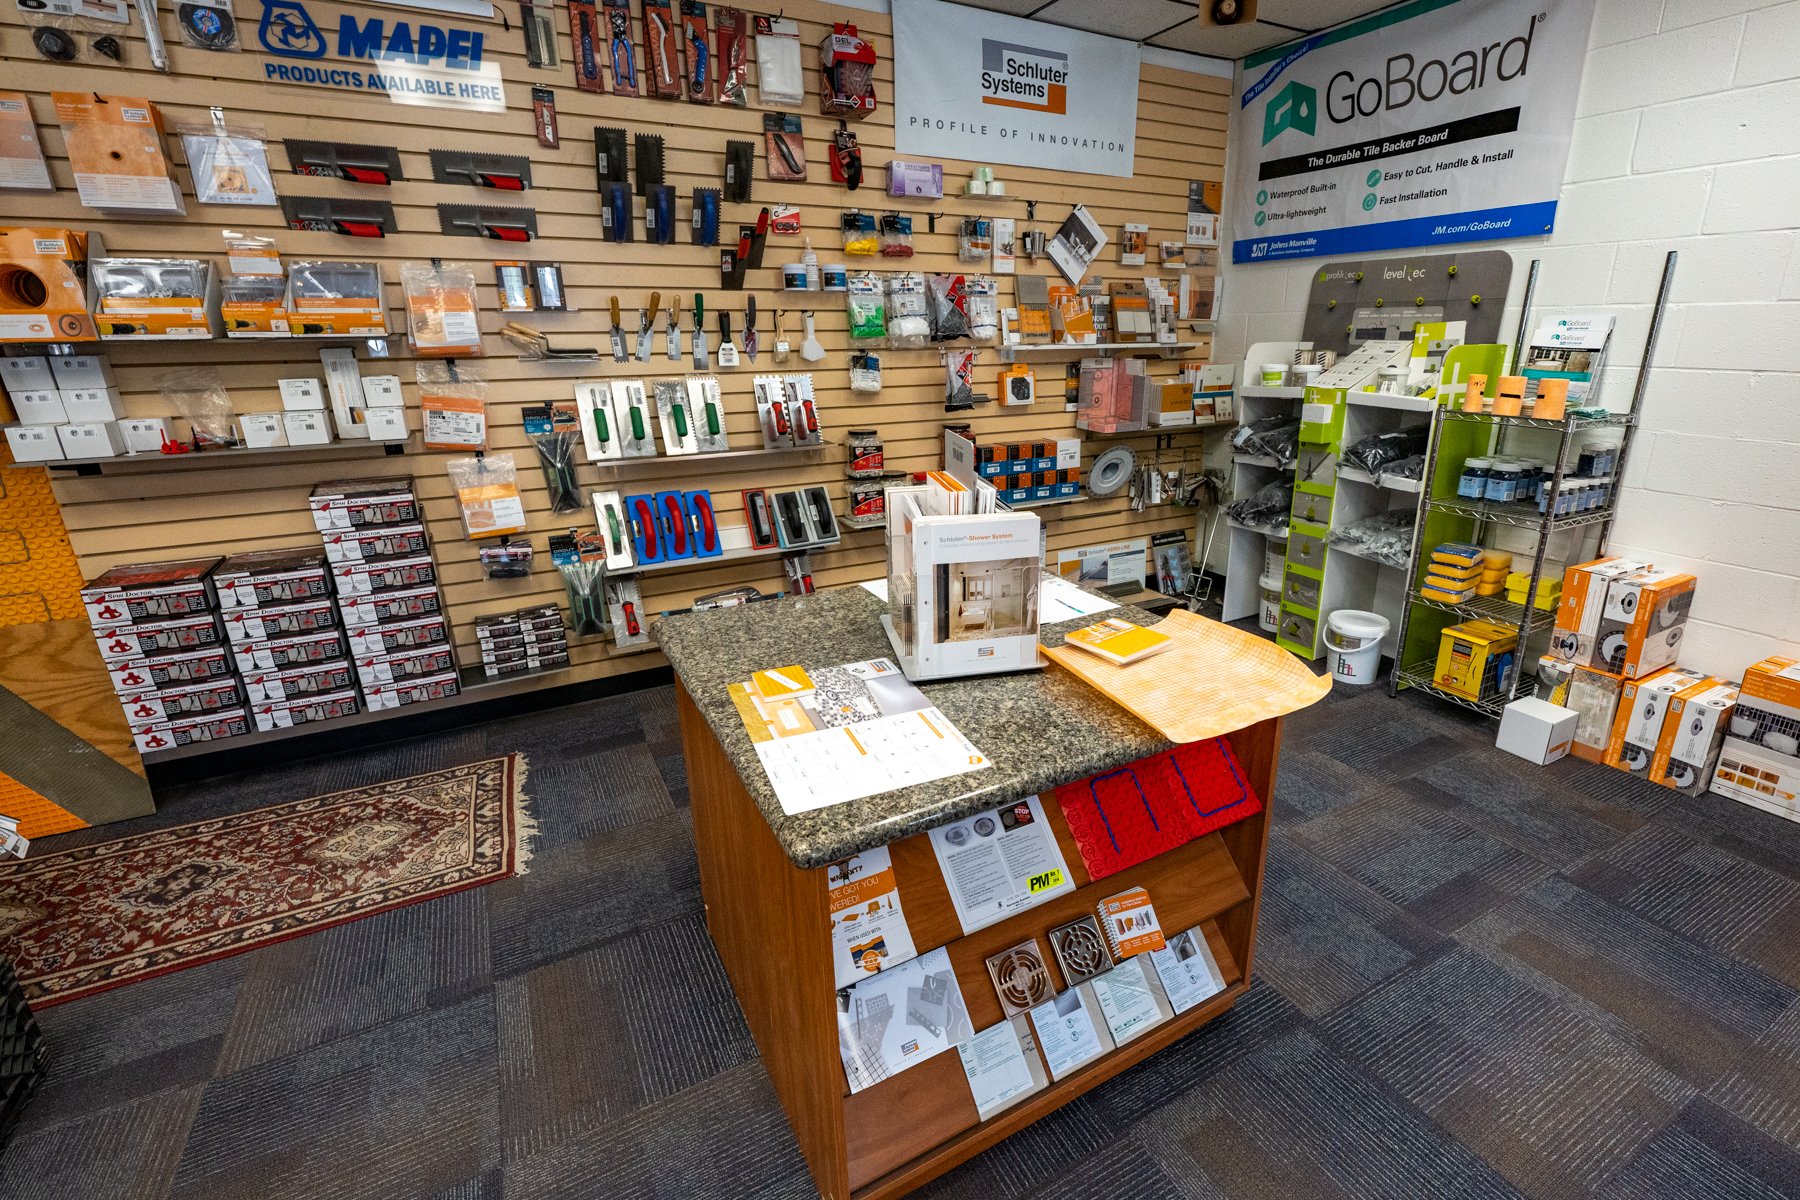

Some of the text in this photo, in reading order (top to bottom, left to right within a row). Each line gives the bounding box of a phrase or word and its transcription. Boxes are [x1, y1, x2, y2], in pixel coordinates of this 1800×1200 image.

[338, 15, 483, 71] MAPEI
[835, 36, 850, 44] GEL
[1006, 58, 1068, 84] Schluter
[1245, 91, 1254, 102] The
[1255, 82, 1264, 93] Tile
[1286, 43, 1309, 63] Choice!
[1326, 15, 1537, 124] GoBoard
[265, 63, 502, 101] PRODUCTS AVAILABLE HERE
[981, 72, 1045, 98] Systems
[910, 116, 1124, 152] PROFILE OF INNOVATION
[1307, 130, 1449, 168] The Durable Tile Backer Board
[1384, 149, 1513, 184] Easy to Cut, Handle & Install
[1269, 182, 1336, 199] Waterproof Built-in
[1379, 186, 1448, 206] Fast Installation
[1268, 206, 1326, 221] Ultra-lightweight
[1432, 218, 1511, 235] JM.com/GoBoard
[1269, 241, 1288, 250] Johns
[1289, 238, 1317, 247] Manville
[148, 656, 174, 664] DOCTOR
[843, 883, 860, 894] GOT
[861, 876, 879, 888] YOU
[1030, 872, 1050, 891] PM
[847, 926, 882, 944] WHEN USED WITH
